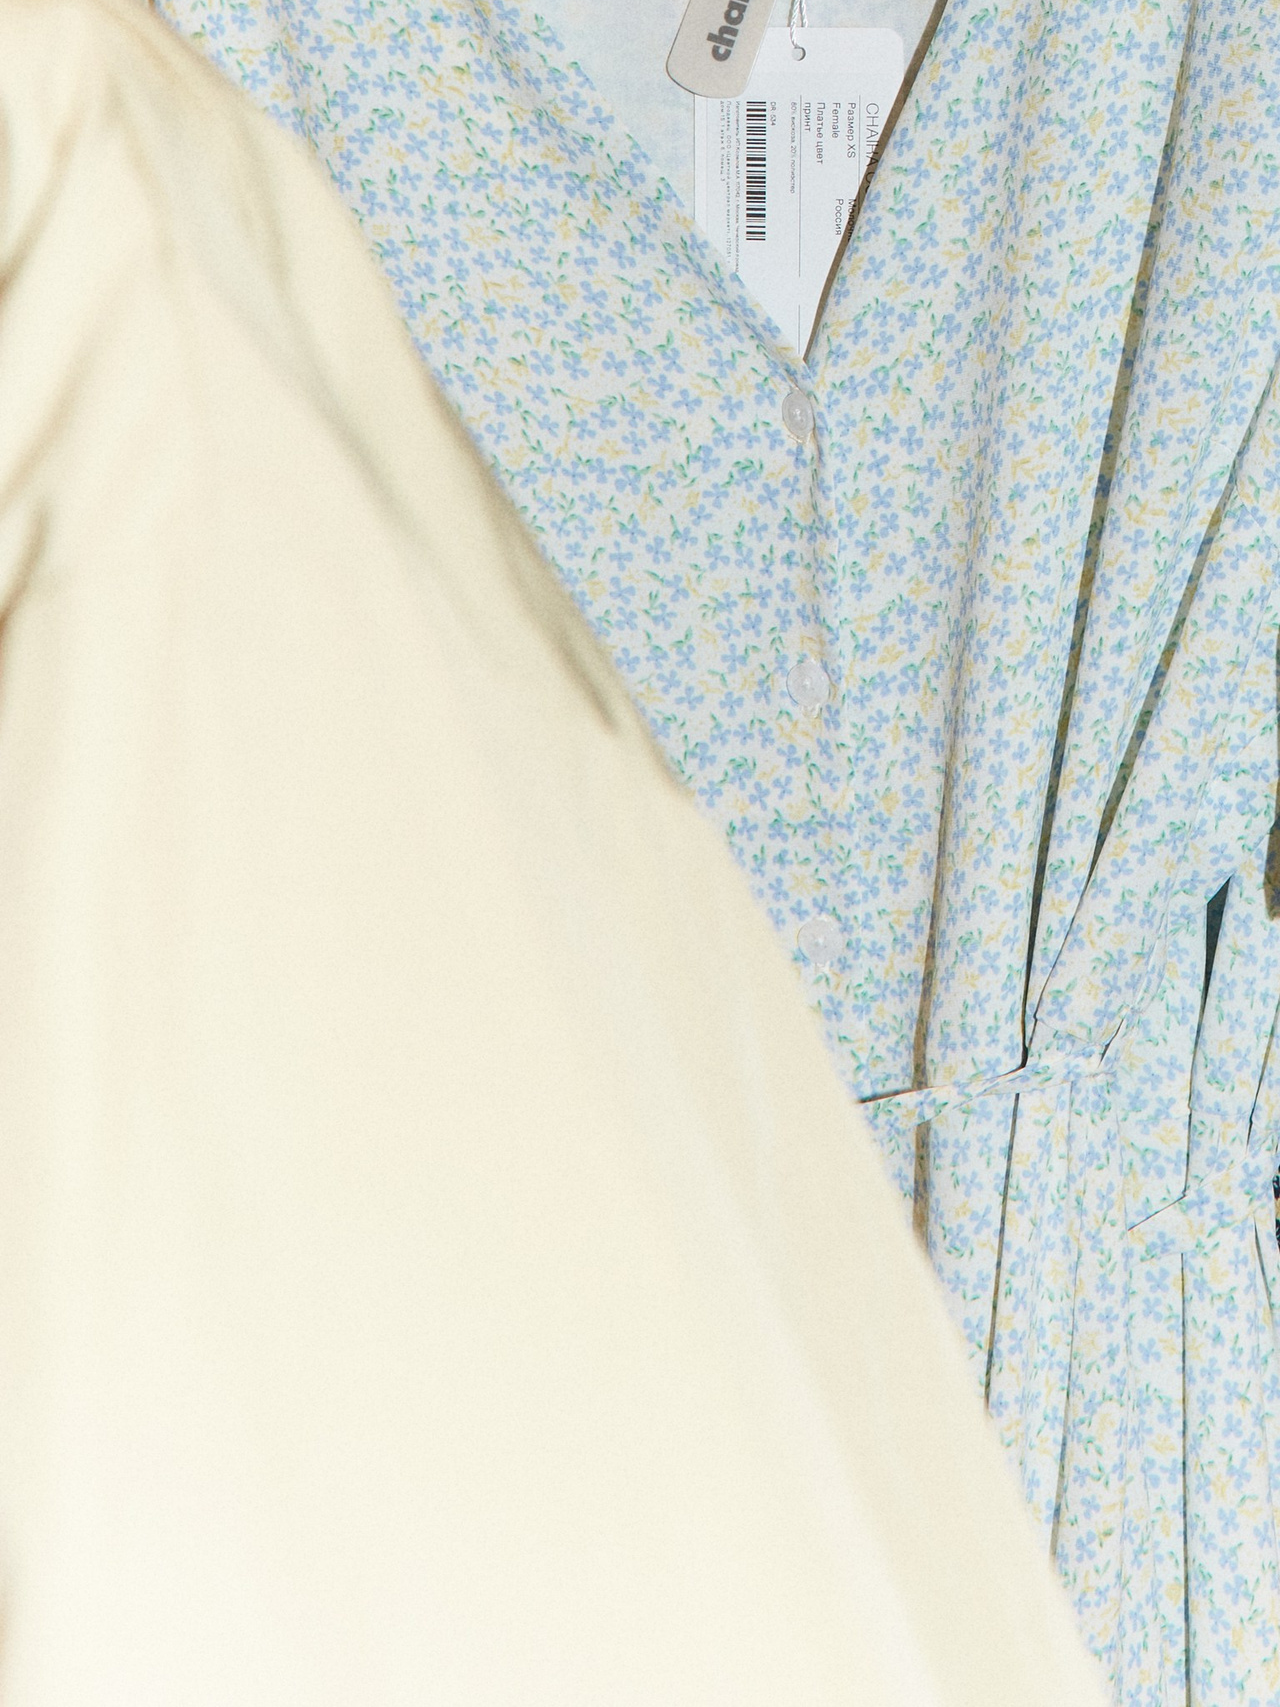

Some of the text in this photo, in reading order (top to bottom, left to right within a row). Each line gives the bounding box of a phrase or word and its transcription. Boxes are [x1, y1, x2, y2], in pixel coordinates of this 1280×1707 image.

[803, 102, 811, 132] принт
[815, 102, 826, 165] Платье цвет
[831, 102, 841, 139] Female
[846, 102, 857, 159] Размер XS
[835, 198, 844, 236] Россия
